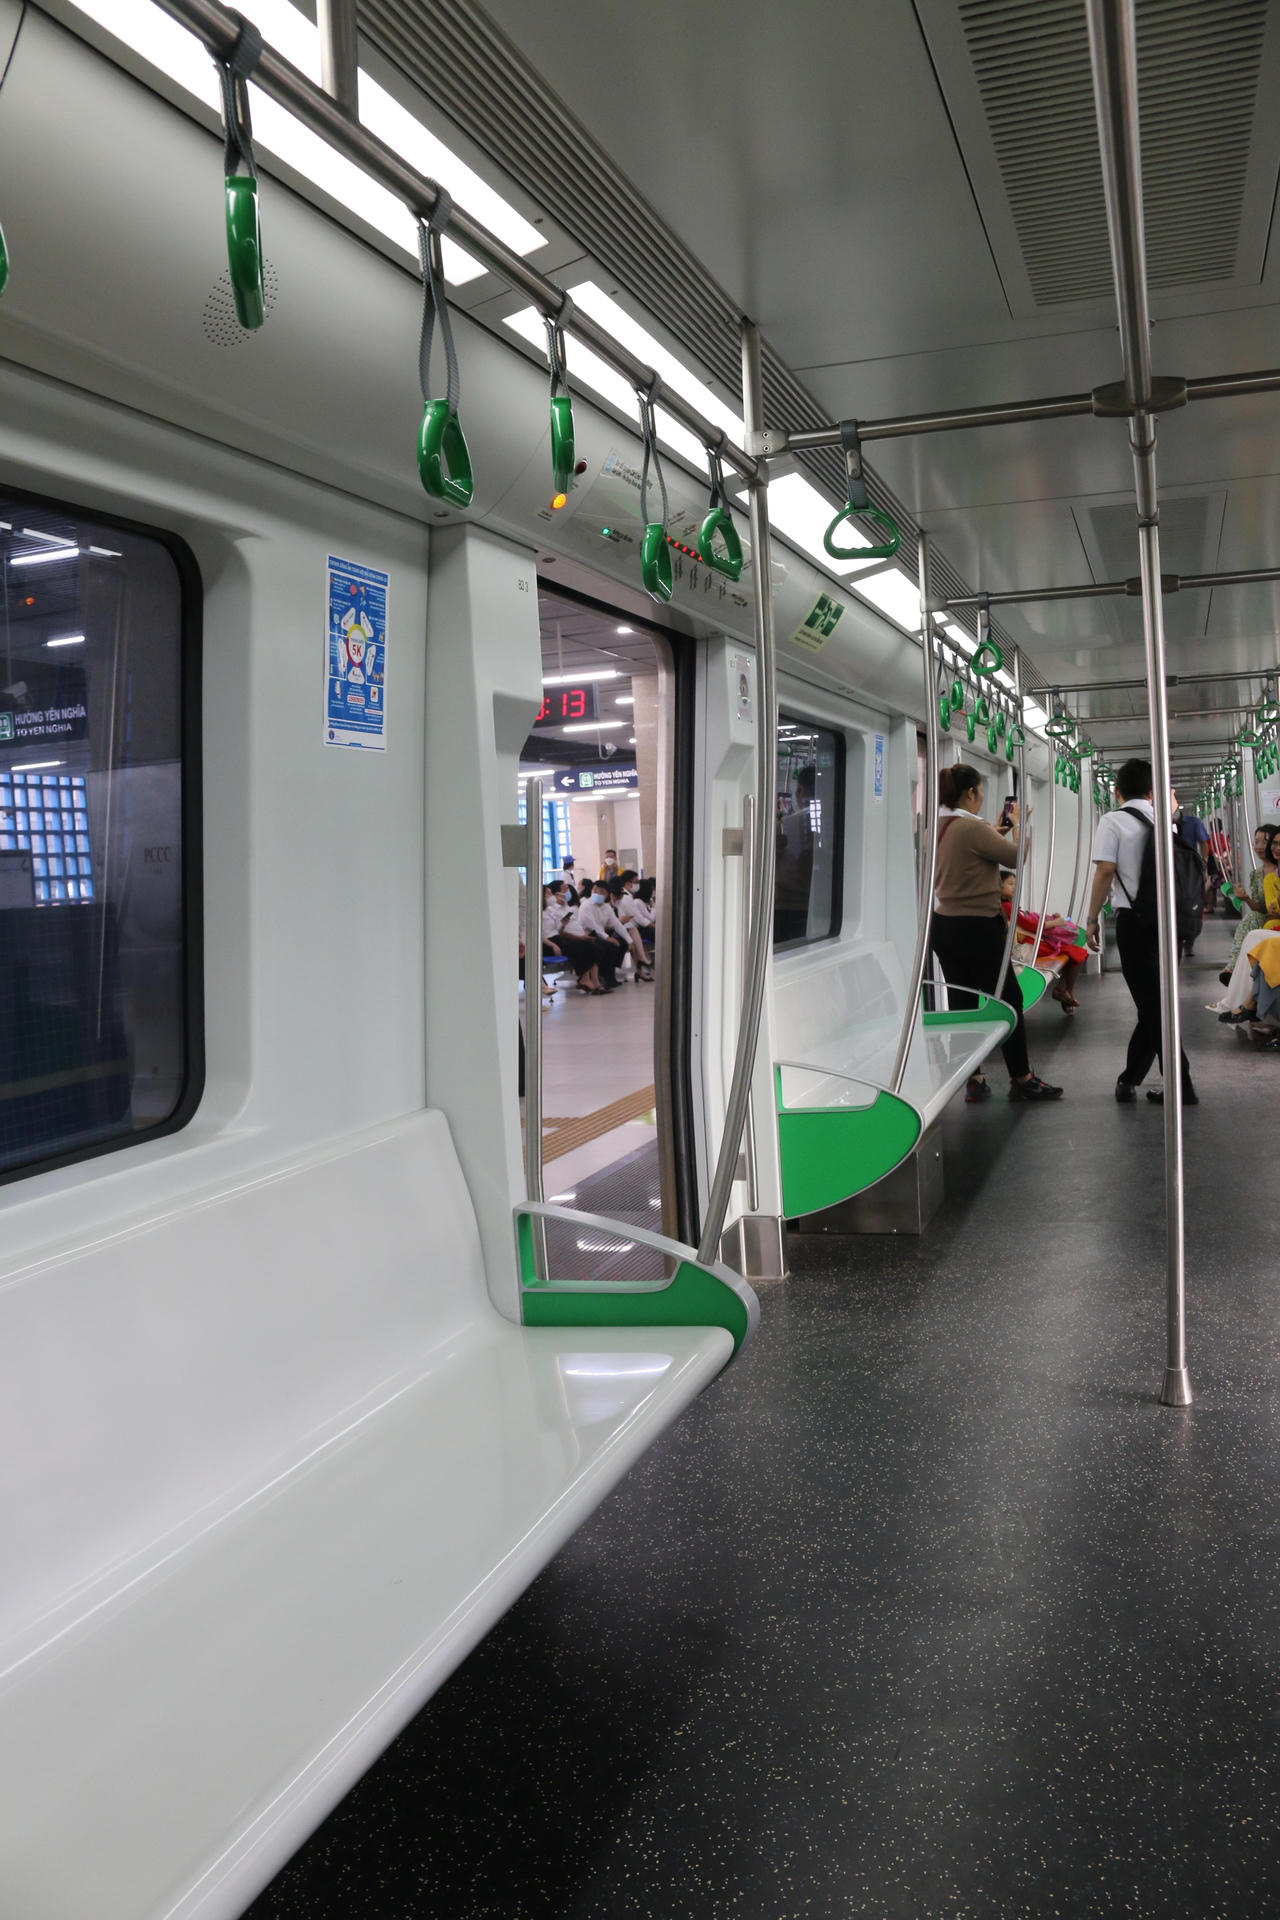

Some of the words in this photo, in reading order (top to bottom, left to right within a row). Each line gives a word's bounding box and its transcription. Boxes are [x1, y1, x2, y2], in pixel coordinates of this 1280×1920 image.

[351, 643, 362, 658] 5K
[45, 706, 60, 721] YÊN
[16, 728, 27, 737] TO
[28, 725, 45, 735] YEN
[46, 722, 73, 734] NGHIA
